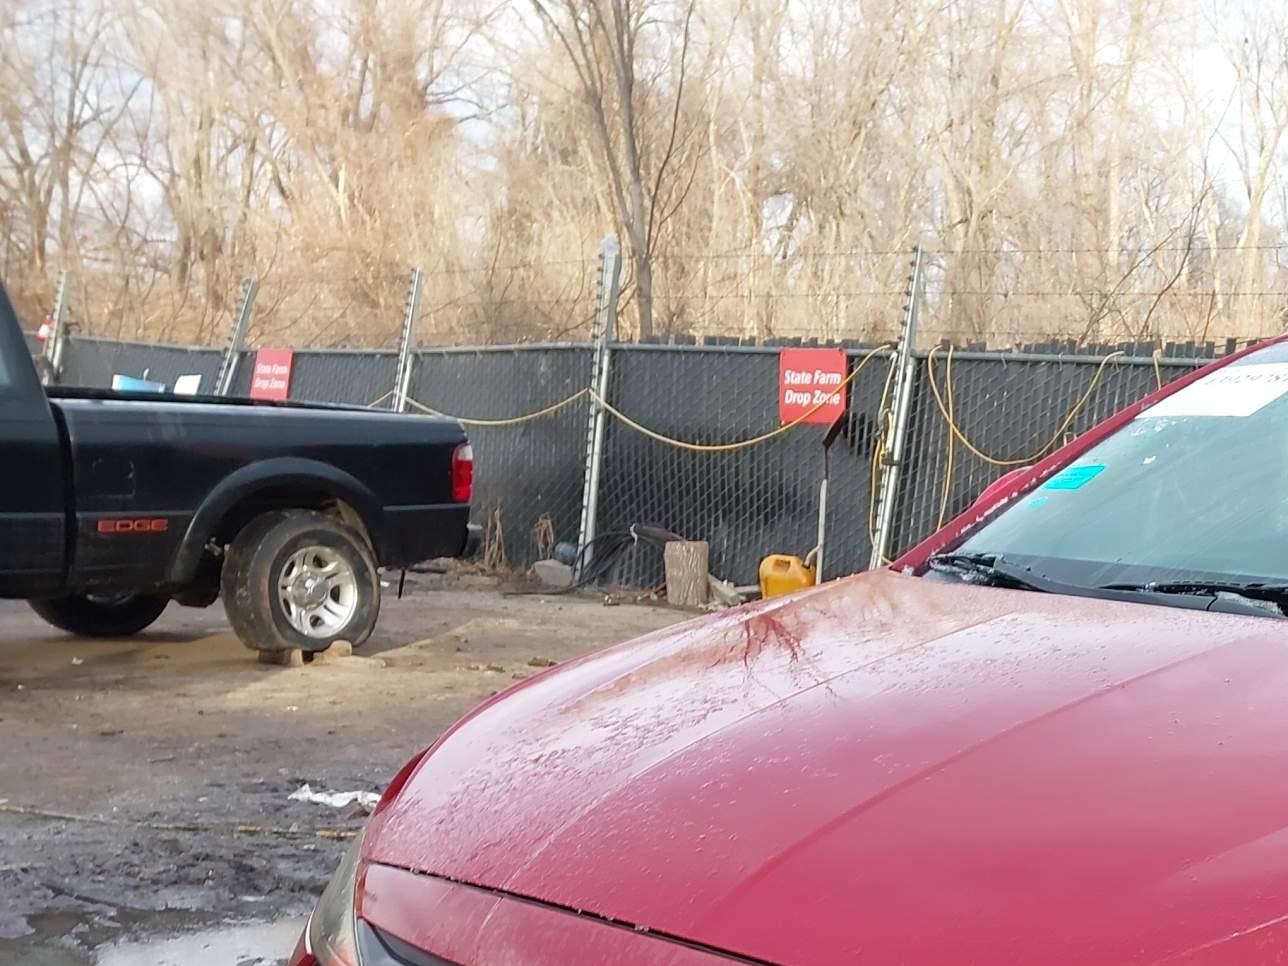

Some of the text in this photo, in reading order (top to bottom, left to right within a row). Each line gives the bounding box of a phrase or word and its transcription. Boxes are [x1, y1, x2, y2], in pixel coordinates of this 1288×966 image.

[784, 369, 842, 385] State Farm
[784, 389, 841, 407] Drop Zone
[98, 519, 169, 532] EDGE
